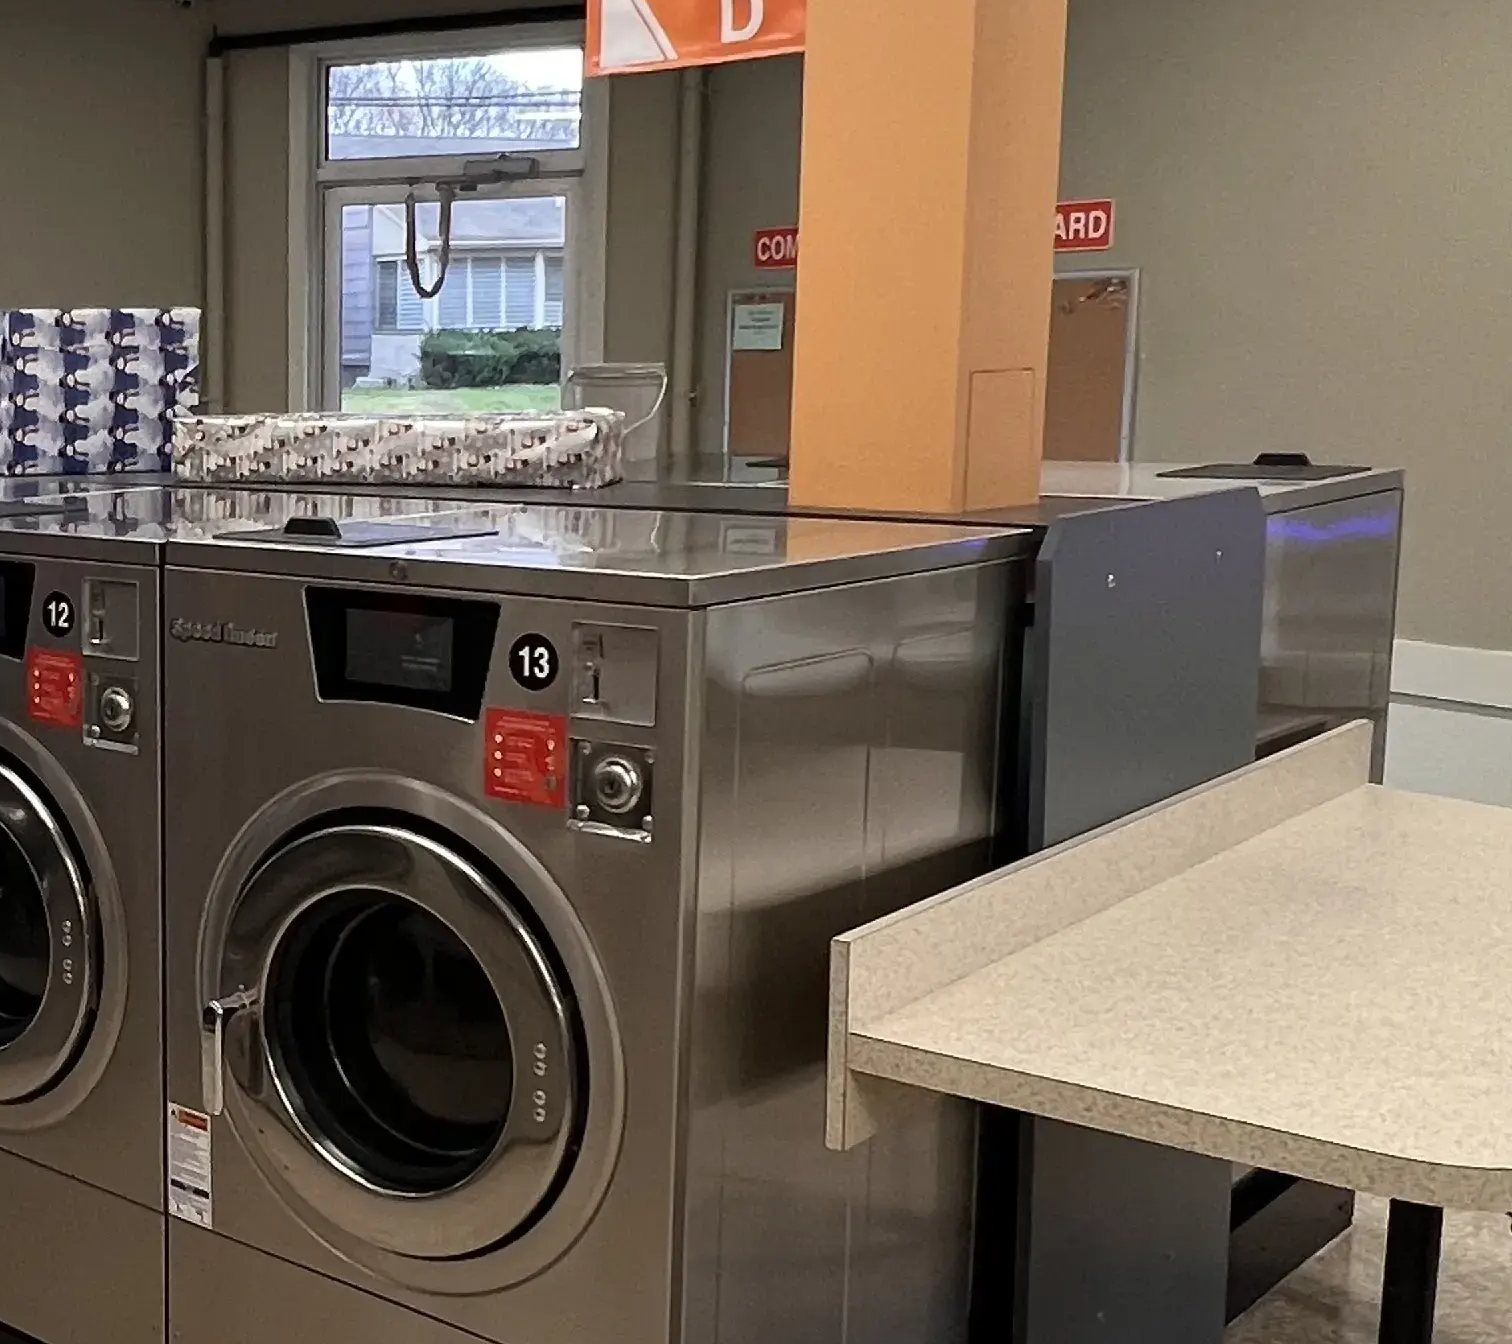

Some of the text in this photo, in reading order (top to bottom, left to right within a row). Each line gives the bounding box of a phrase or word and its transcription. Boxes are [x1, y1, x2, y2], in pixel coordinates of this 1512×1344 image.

[757, 209, 1107, 261] COM ARD
[47, 601, 70, 628] 12
[519, 646, 550, 679] 13
